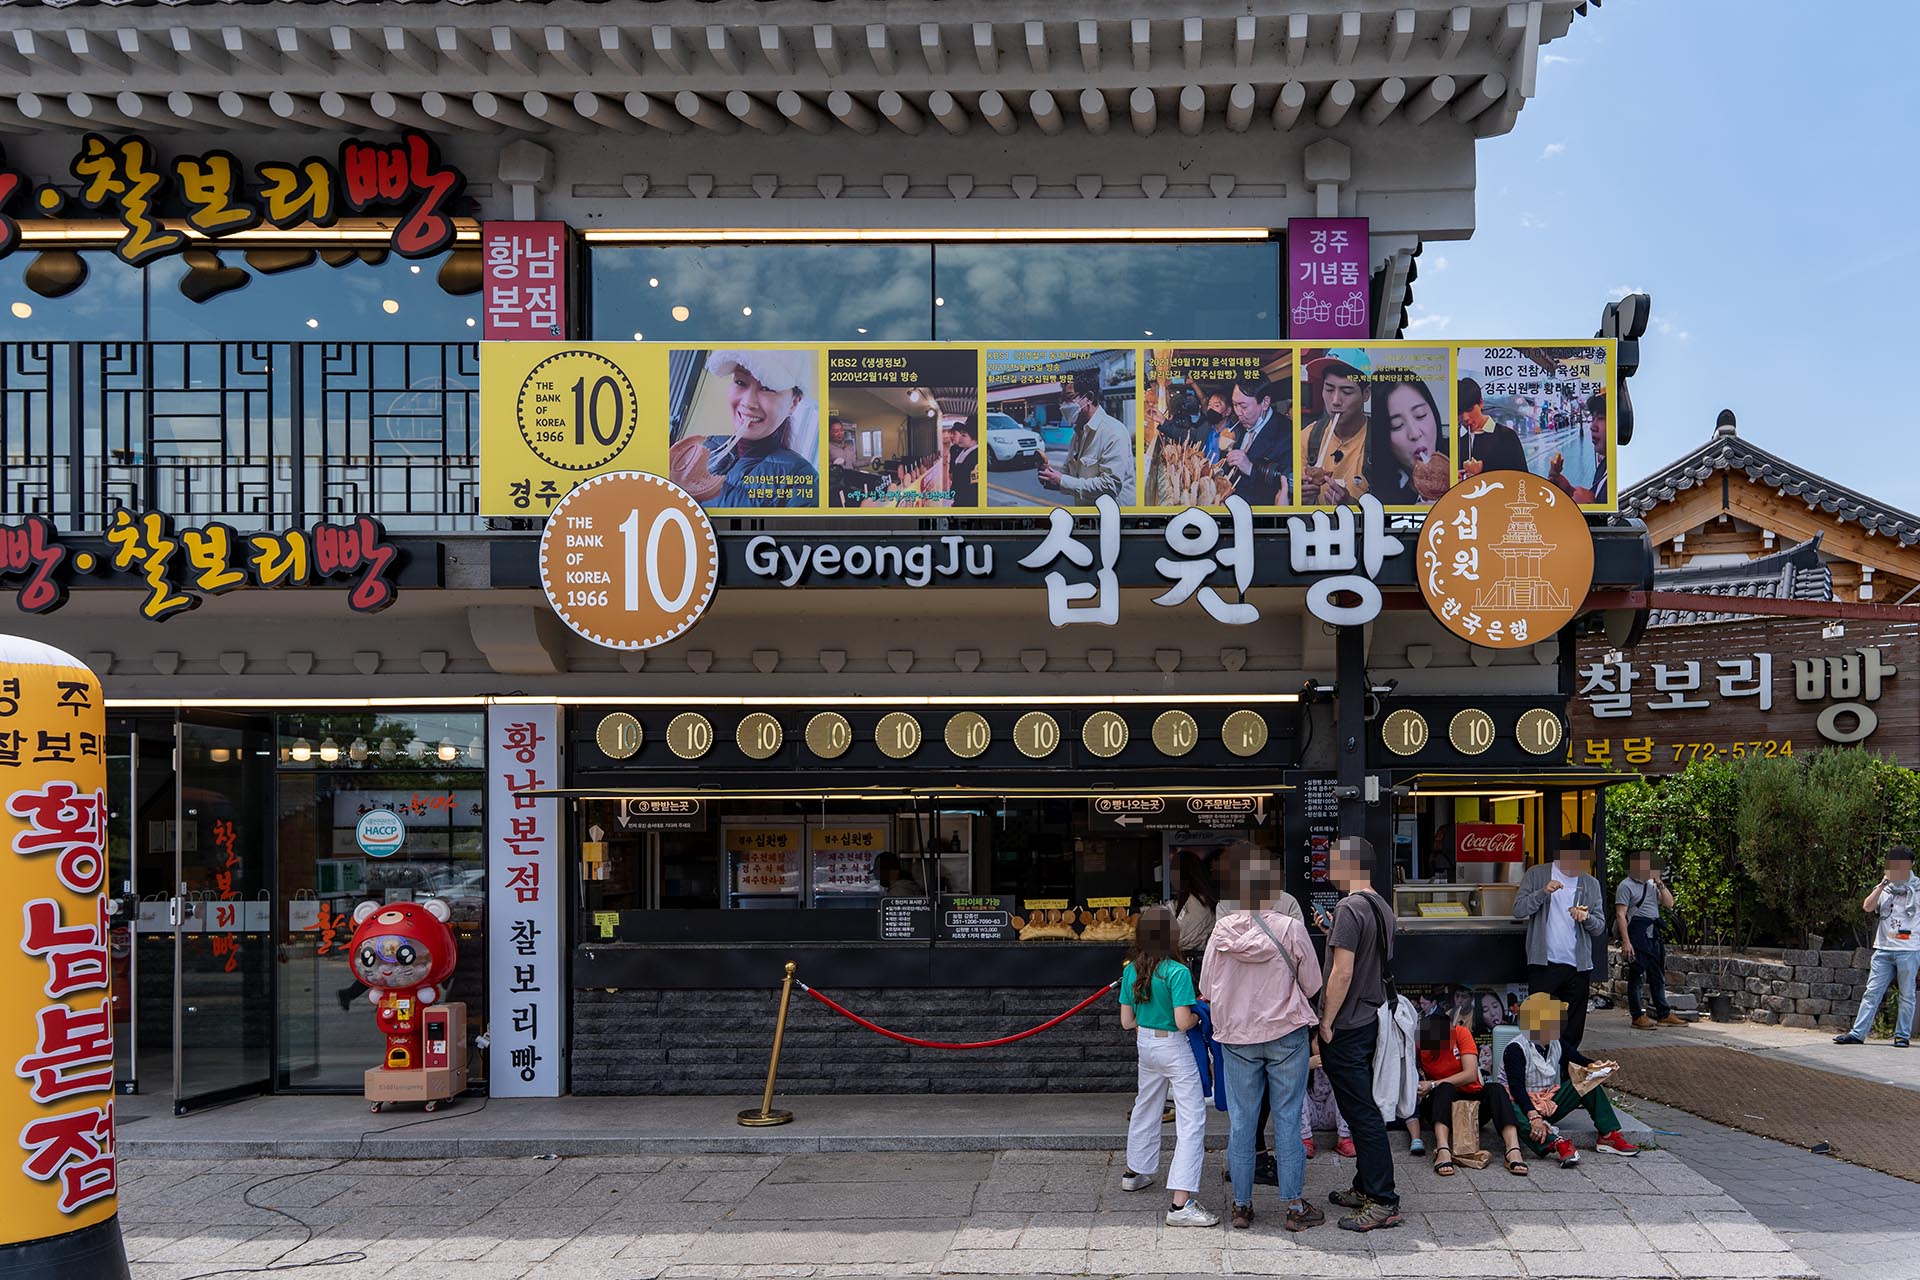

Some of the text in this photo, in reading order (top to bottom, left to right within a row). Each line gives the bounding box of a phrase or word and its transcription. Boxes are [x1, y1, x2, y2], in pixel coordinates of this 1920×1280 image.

[77, 134, 456, 260] 찰보리빵
[1310, 230, 1349, 254] 경주
[488, 236, 559, 279] 황남
[1300, 262, 1359, 285] 기념품
[489, 285, 559, 329] 본점
[831, 358, 857, 368] KBS2
[1485, 366, 1513, 377] MBC
[536, 382, 554, 390] THE
[831, 372, 918, 382] 2020년2월14일 방송
[1060, 375, 1074, 383] 방문
[1244, 370, 1260, 380] 방문
[536, 394, 561, 402] BANK
[1485, 382, 1539, 395] 경주십원빵
[1580, 381, 1602, 394] 본점
[536, 406, 548, 415] OF
[571, 375, 624, 446] 10
[536, 419, 566, 427] KOREA
[536, 431, 564, 442] 1966
[743, 475, 814, 485] 2019년12월20일
[508, 478, 562, 509] 경주
[747, 487, 814, 498] 십원빵 탄생 기념
[566, 517, 593, 528] THE
[566, 535, 604, 547] BANK
[1451, 505, 1480, 581] 십원
[108, 511, 394, 618] 찰보리빵
[566, 553, 584, 565] OF
[618, 507, 698, 613] 10
[745, 535, 993, 587] GyeongJu
[1017, 494, 1405, 626] 십원빵
[566, 571, 611, 583] KOREA
[566, 590, 609, 606] 1966
[1441, 597, 1528, 642] 한국은행
[1579, 648, 1897, 743] 찰보리빵
[616, 722, 637, 750] 10
[686, 722, 708, 750] 10
[756, 722, 777, 750] 10
[895, 721, 916, 749] 10
[965, 721, 986, 749] 10
[1033, 721, 1054, 749] 10
[1102, 720, 1123, 748] 10
[1402, 718, 1424, 746] 10
[1468, 718, 1490, 746] 10
[1536, 718, 1557, 746] 10
[1566, 737, 1794, 765] 보당 772-5724
[651, 801, 689, 812] 빵받는곳
[1112, 800, 1160, 810] 빵나오는곳
[1203, 800, 1252, 810] 주문받는곳
[365, 826, 397, 835] HACCP
[755, 834, 788, 847] 십원빵
[841, 832, 873, 846] 십원빵
[1461, 833, 1517, 853] Coca-Cola
[212, 819, 242, 974] 찰보리빵
[502, 722, 546, 1083] 황남본점 찰보리빵
[985, 898, 1001, 906] 가능
[8, 780, 117, 1215] 황남본점
